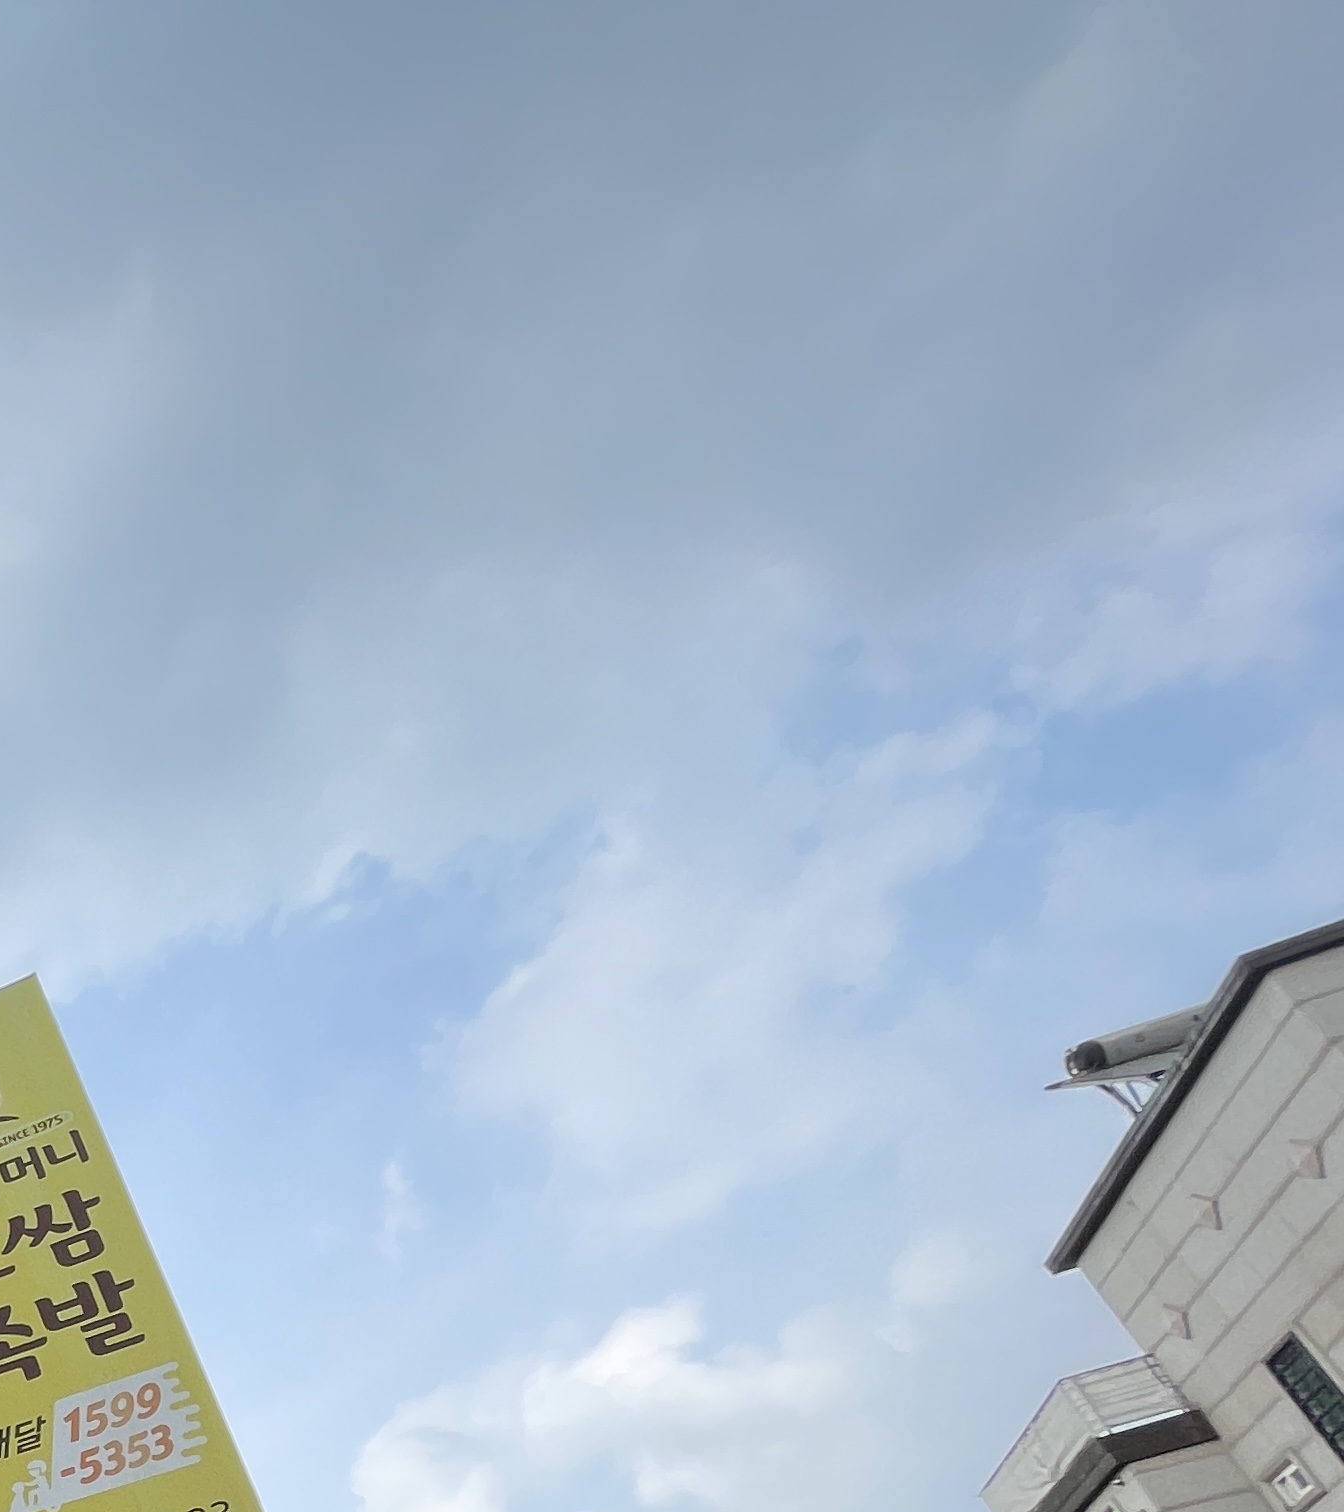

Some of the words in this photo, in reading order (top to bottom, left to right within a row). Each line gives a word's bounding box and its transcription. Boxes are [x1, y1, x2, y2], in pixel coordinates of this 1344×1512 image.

[31, 1114, 64, 1134] 1975
[63, 1381, 162, 1444] 1599
[59, 1424, 175, 1487] -5353
